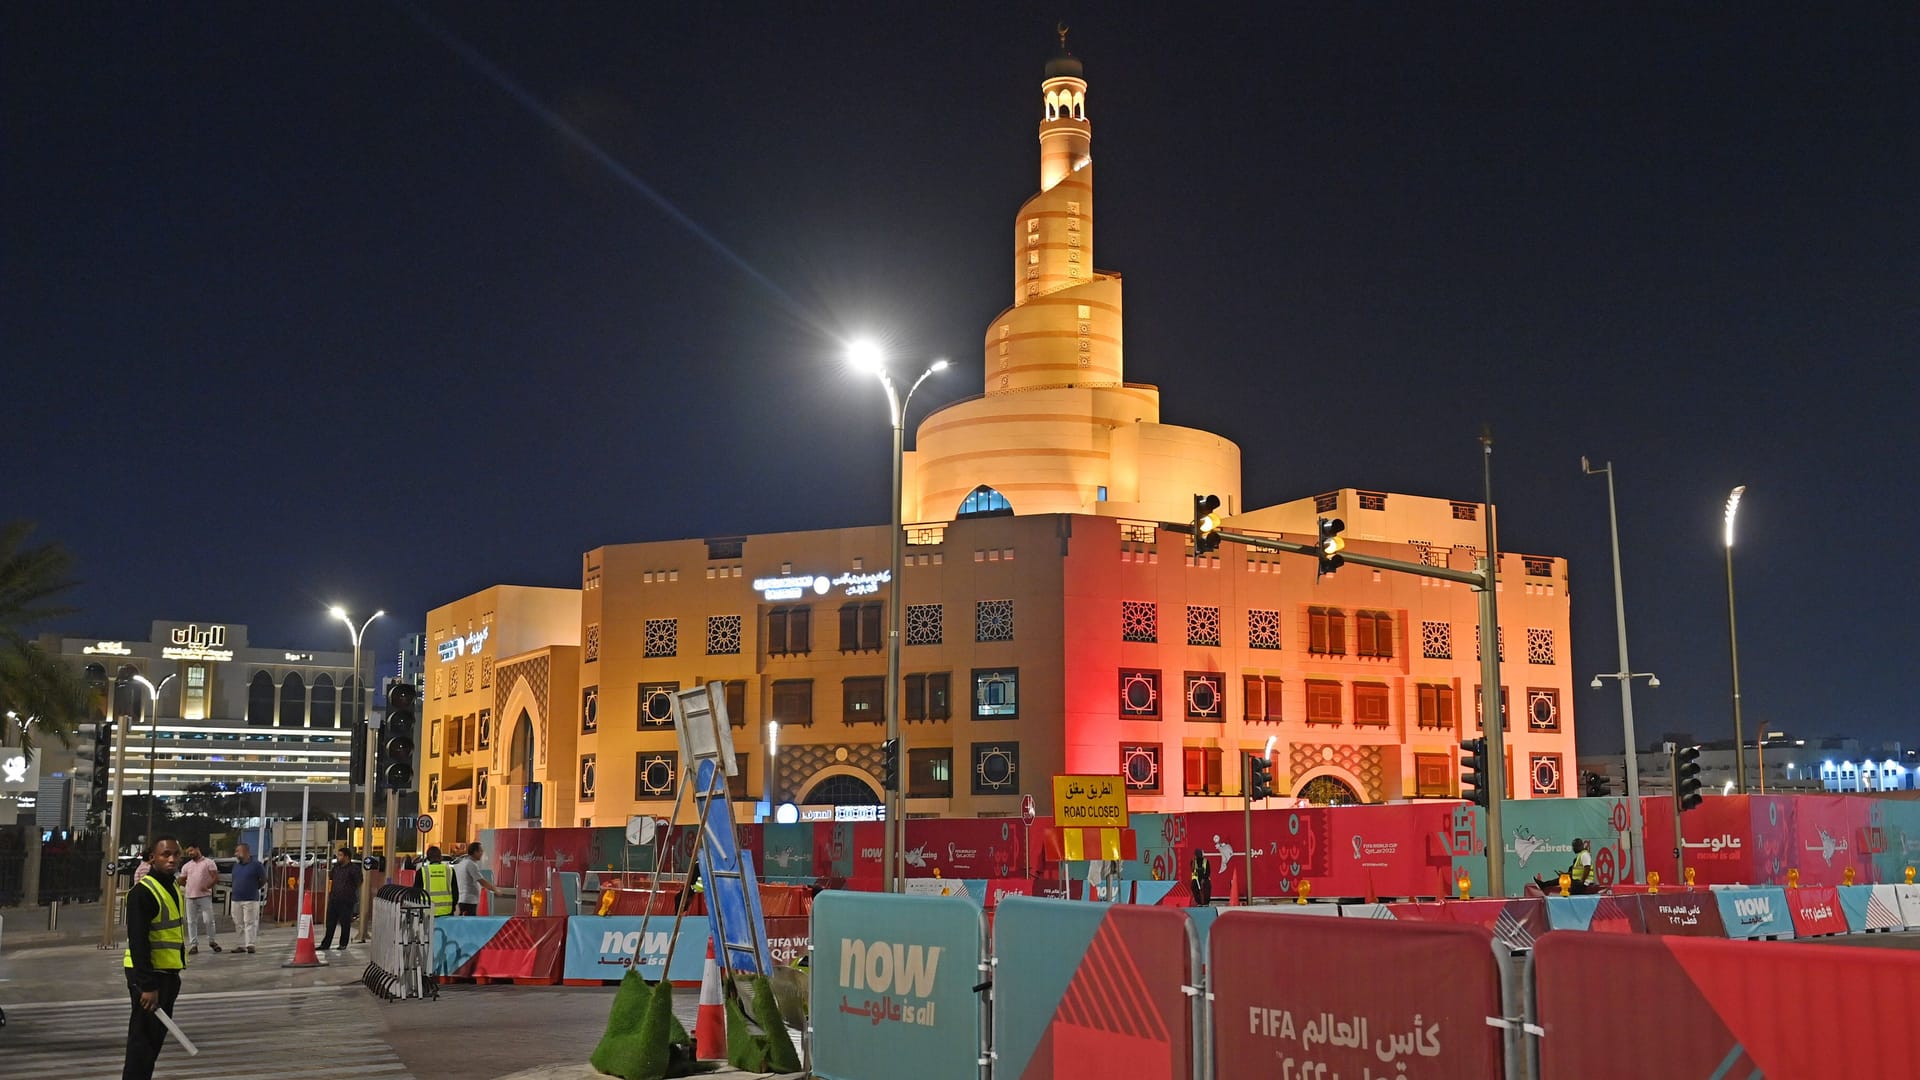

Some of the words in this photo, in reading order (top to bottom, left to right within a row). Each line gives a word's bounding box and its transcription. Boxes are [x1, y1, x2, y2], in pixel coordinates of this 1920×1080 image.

[171, 624, 226, 650] الريان
[1066, 781, 1084, 800] مغلق
[1087, 781, 1112, 800] الطريق
[1064, 806, 1086, 818] ROAD
[1088, 805, 1120, 818] CLOSED
[420, 819, 430, 828] 50
[861, 847, 883, 858] now
[1681, 834, 1741, 852] عالوعد
[1734, 896, 1770, 917] now
[600, 931, 680, 955] now
[767, 937, 792, 948] FIFA
[839, 938, 940, 998] now
[839, 995, 901, 1026] عالوعد
[902, 998, 915, 1023] is
[916, 1001, 935, 1026] all
[1249, 1006, 1296, 1040] FIFA
[1303, 1013, 1368, 1050] العالم
[1376, 1014, 1441, 1062] كأس
